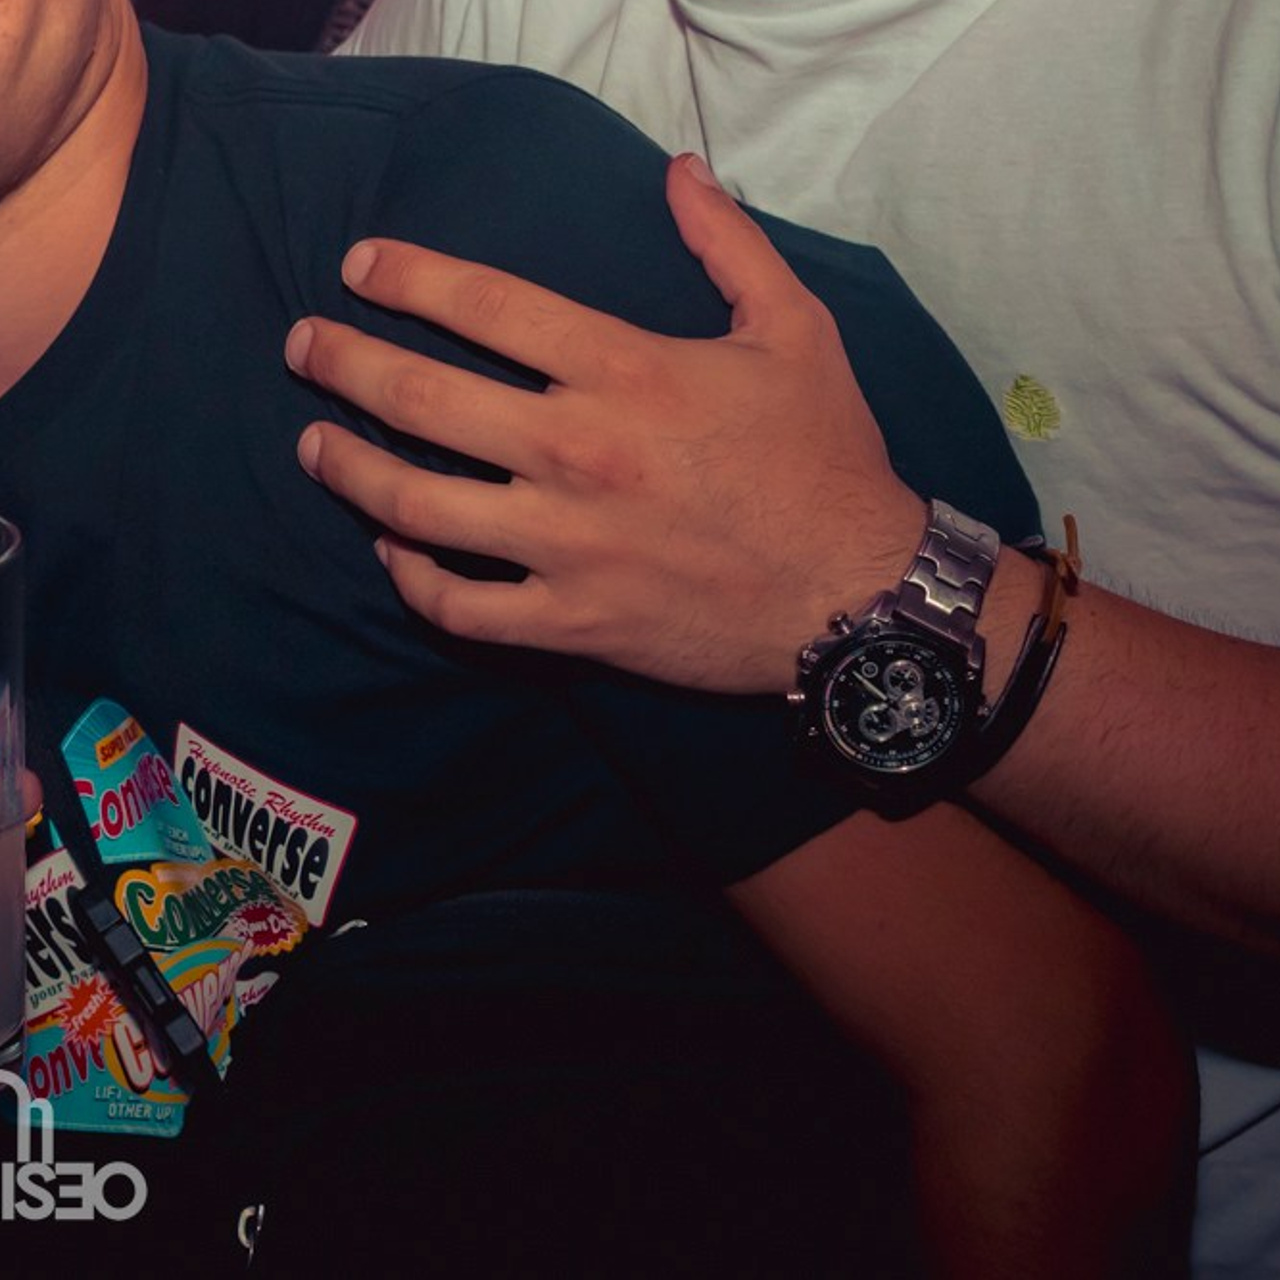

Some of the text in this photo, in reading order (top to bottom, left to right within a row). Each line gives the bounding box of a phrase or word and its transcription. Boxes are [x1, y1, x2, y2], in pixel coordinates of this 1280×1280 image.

[261, 790, 336, 838] Rhythm
[29, 980, 65, 1009] your
[108, 1103, 151, 1119] OTHER
